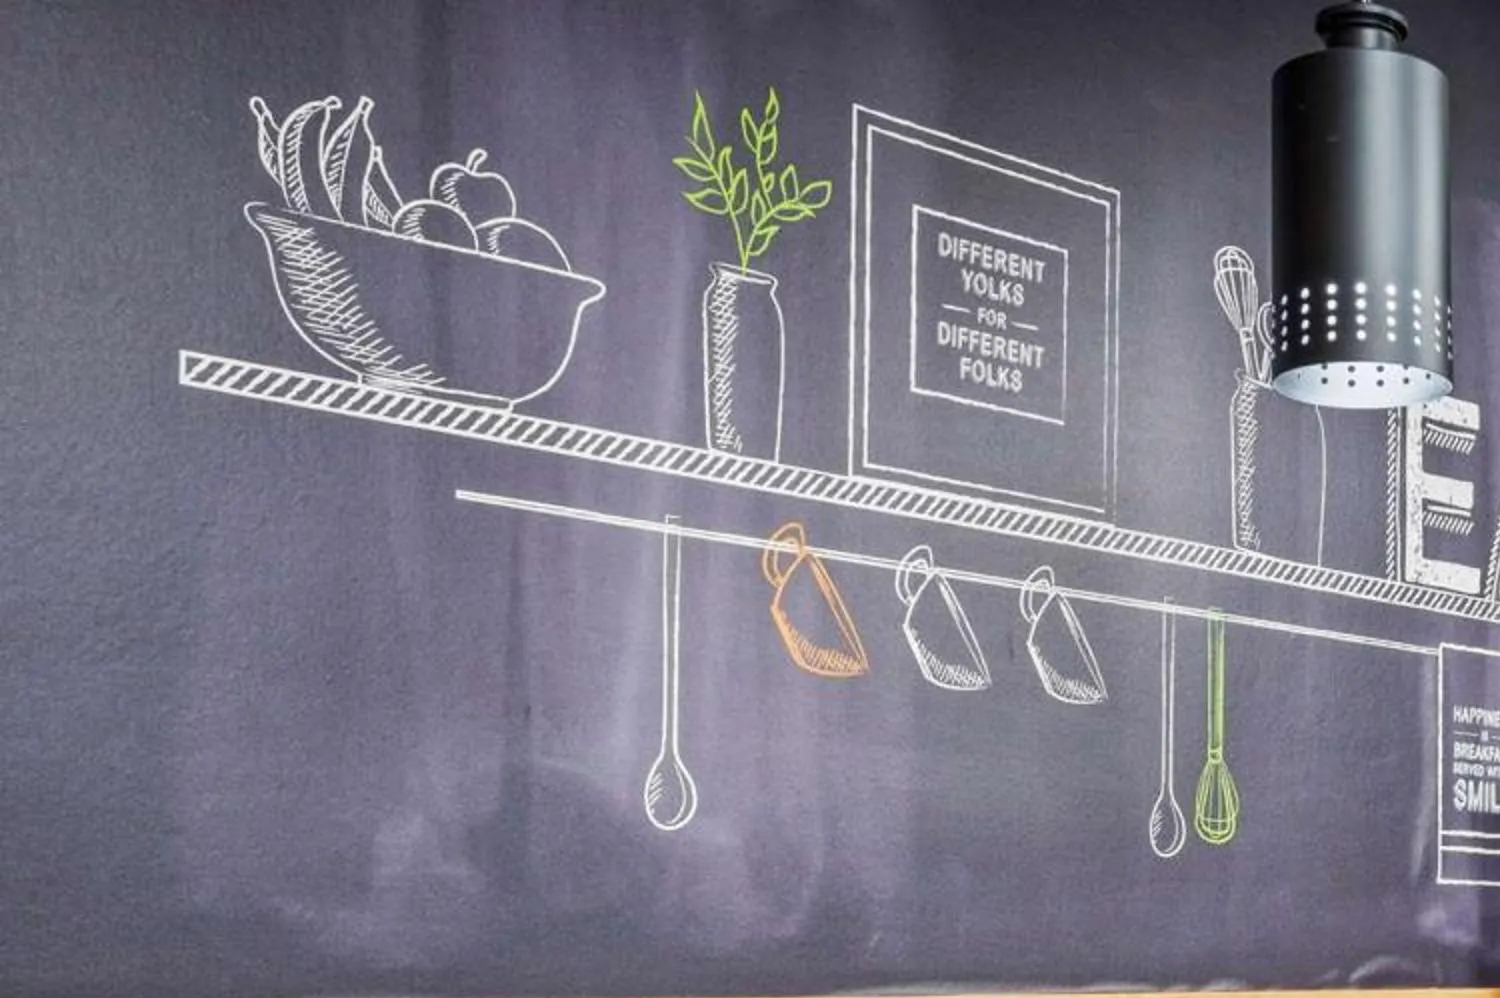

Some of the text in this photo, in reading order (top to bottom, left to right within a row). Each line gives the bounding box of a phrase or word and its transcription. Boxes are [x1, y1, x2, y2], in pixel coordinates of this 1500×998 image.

[938, 232, 1046, 284] DIFFERENT
[961, 269, 1025, 307] YOLKS
[977, 307, 1007, 331] FOR
[937, 321, 1045, 369] DIFFERENT
[959, 357, 1023, 393] FOLKS
